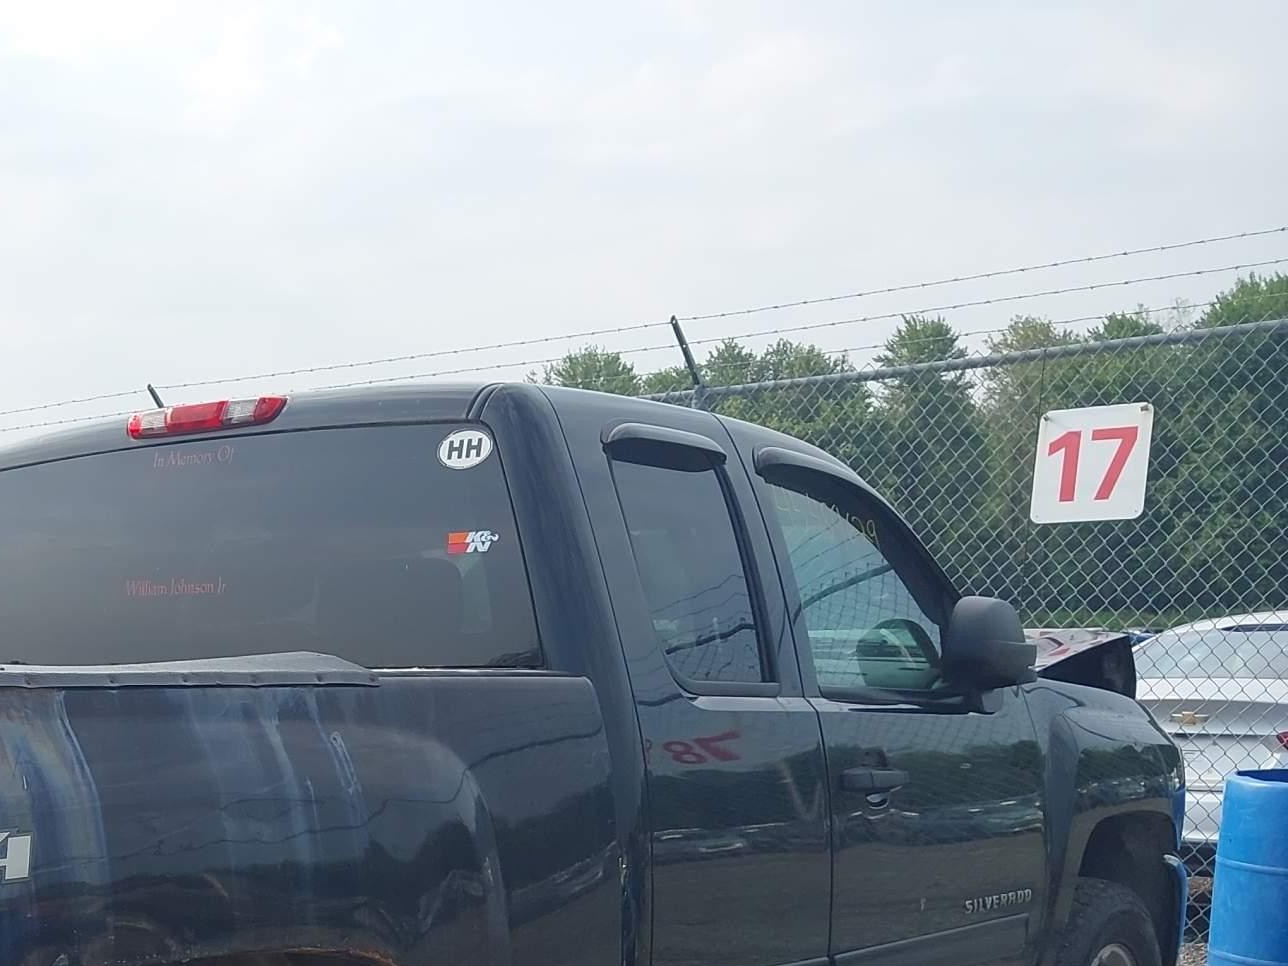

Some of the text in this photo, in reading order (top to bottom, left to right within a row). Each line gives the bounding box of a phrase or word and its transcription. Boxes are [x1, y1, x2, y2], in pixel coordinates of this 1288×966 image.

[446, 437, 483, 460] HH
[1047, 425, 1139, 503] 17
[125, 578, 169, 596] William
[170, 577, 215, 597] Johnson
[965, 888, 1032, 914] SILVERADO
